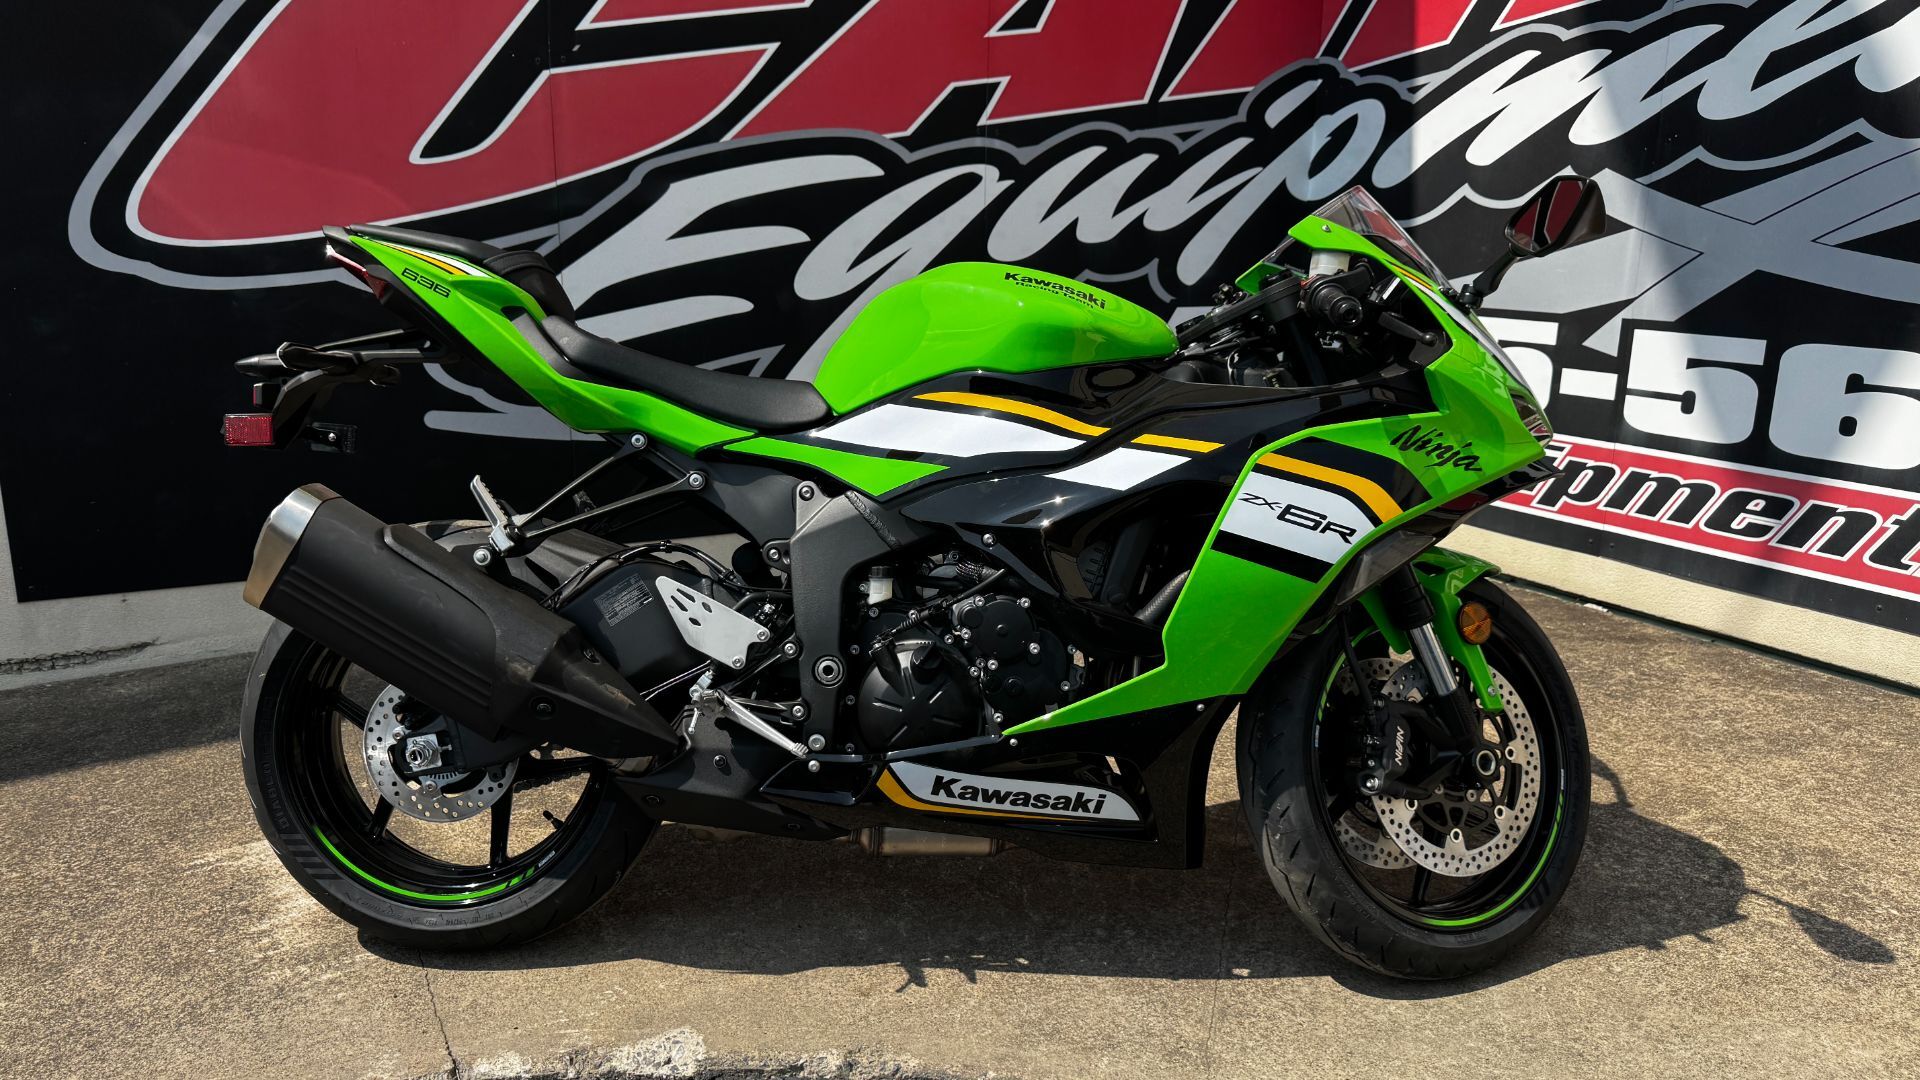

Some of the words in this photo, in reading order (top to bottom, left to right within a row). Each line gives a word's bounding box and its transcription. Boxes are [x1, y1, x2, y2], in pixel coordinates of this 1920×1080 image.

[401, 267, 451, 298] 636
[1004, 272, 1106, 309] Kawasaki
[1015, 281, 1059, 295] Racing
[1063, 292, 1094, 309] Team
[1389, 424, 1482, 472] Ninja
[1237, 492, 1358, 545] ZX-6R
[930, 774, 1107, 815] Kawasaki
